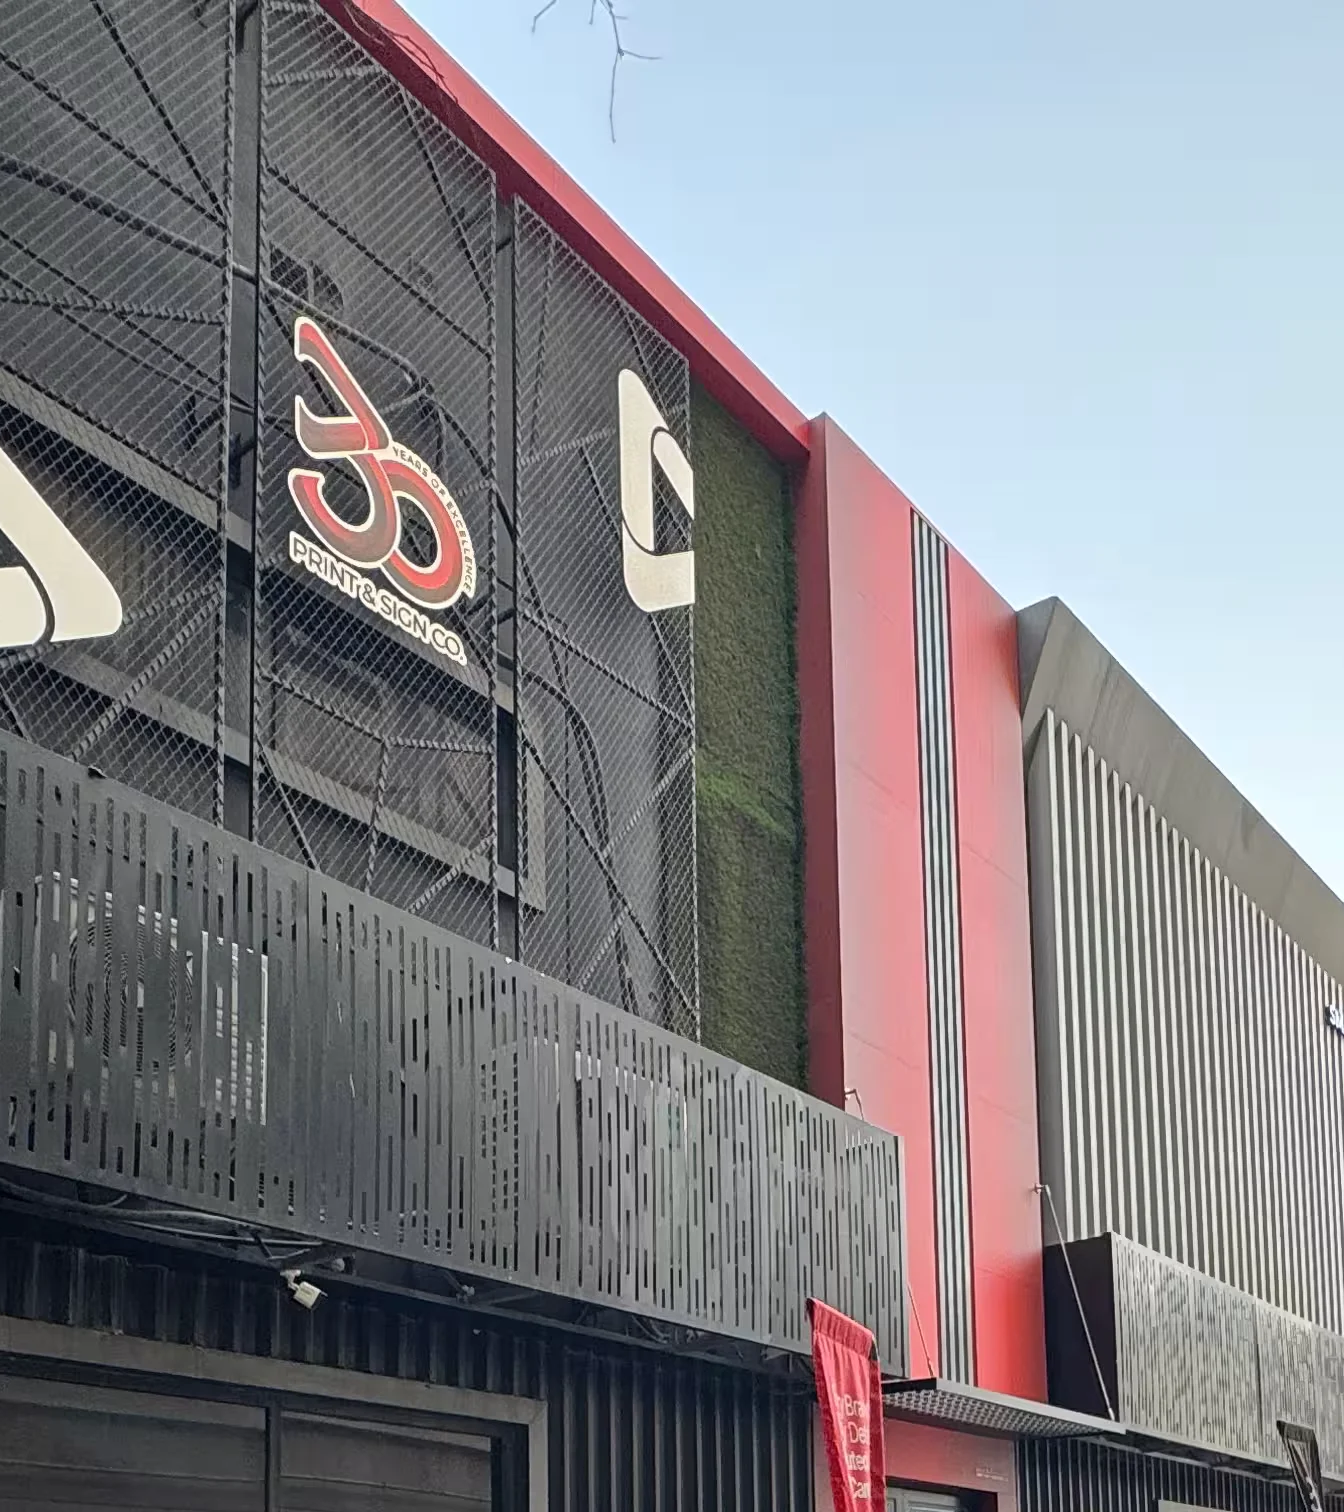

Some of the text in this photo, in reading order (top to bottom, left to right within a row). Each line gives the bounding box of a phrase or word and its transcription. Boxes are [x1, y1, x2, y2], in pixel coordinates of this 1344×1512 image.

[392, 445, 473, 593] YEARS OF EXCELLENCE
[293, 537, 464, 661] PRINT & SIGN CO.
